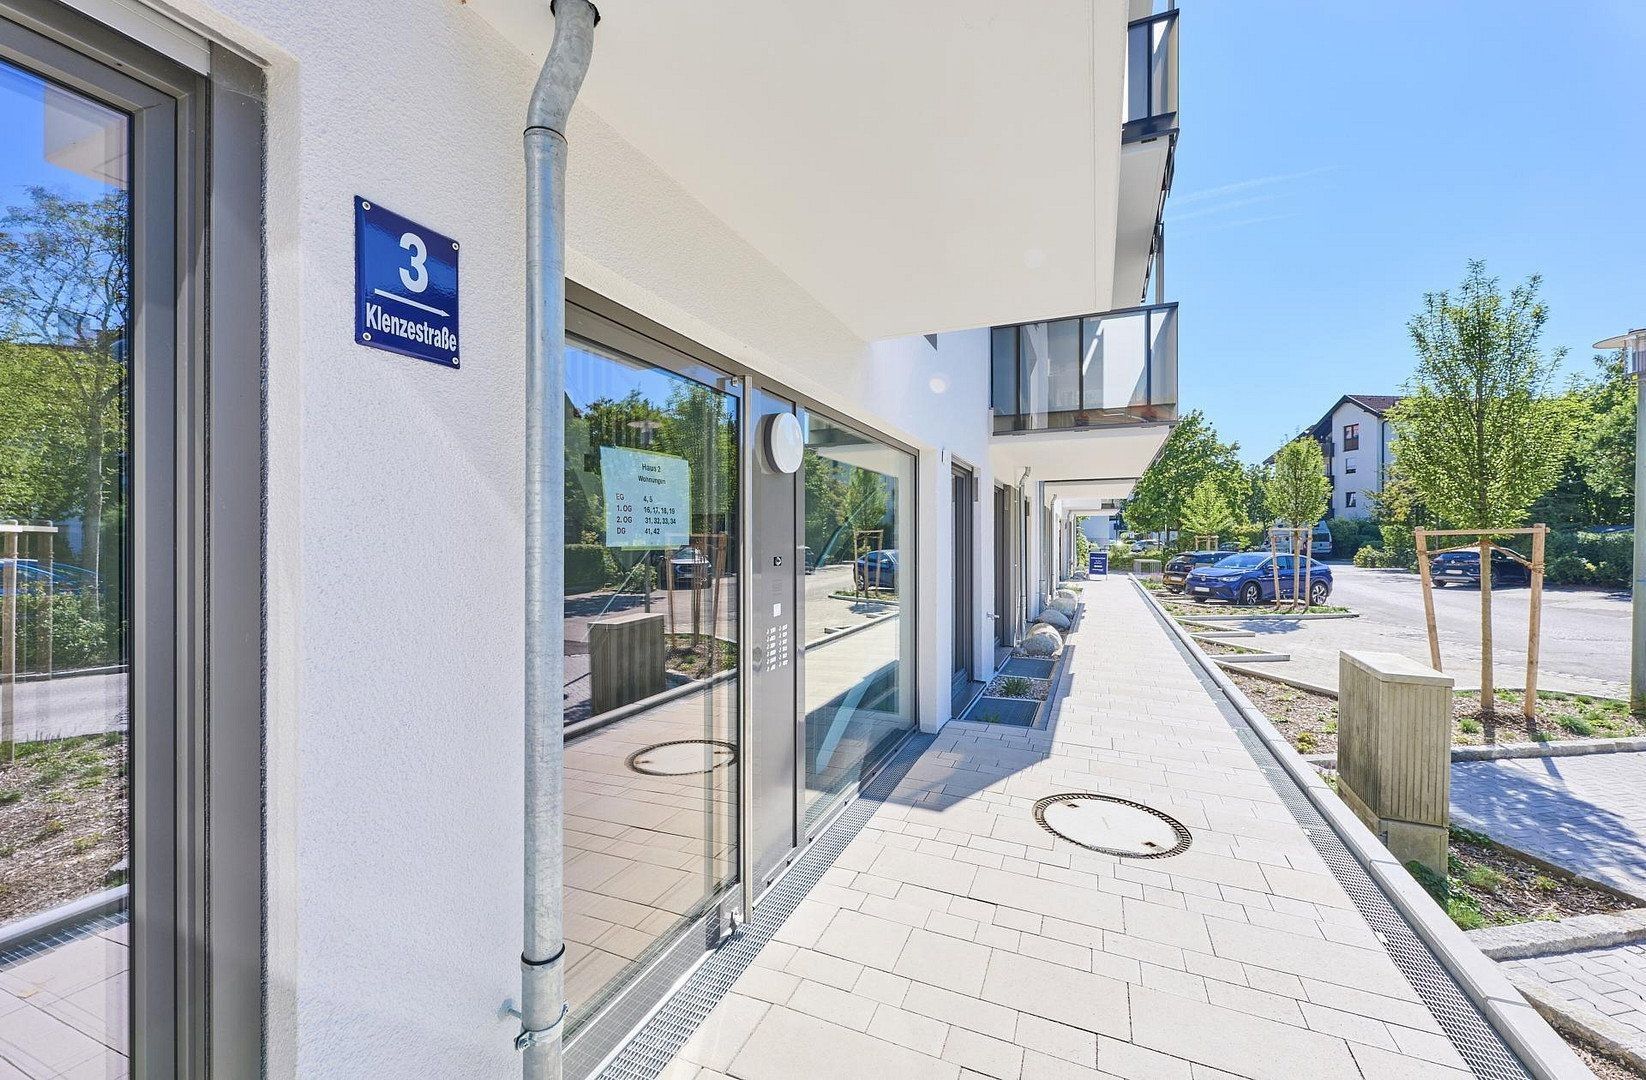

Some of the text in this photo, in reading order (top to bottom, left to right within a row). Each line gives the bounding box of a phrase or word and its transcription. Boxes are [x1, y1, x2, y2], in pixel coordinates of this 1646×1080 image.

[399, 232, 429, 293] 3
[366, 302, 457, 352] Klenzestraße
[641, 463, 661, 473] Haus 2
[638, 475, 666, 485] Wohnungen
[616, 493, 624, 501] EG
[617, 527, 626, 535] DG
